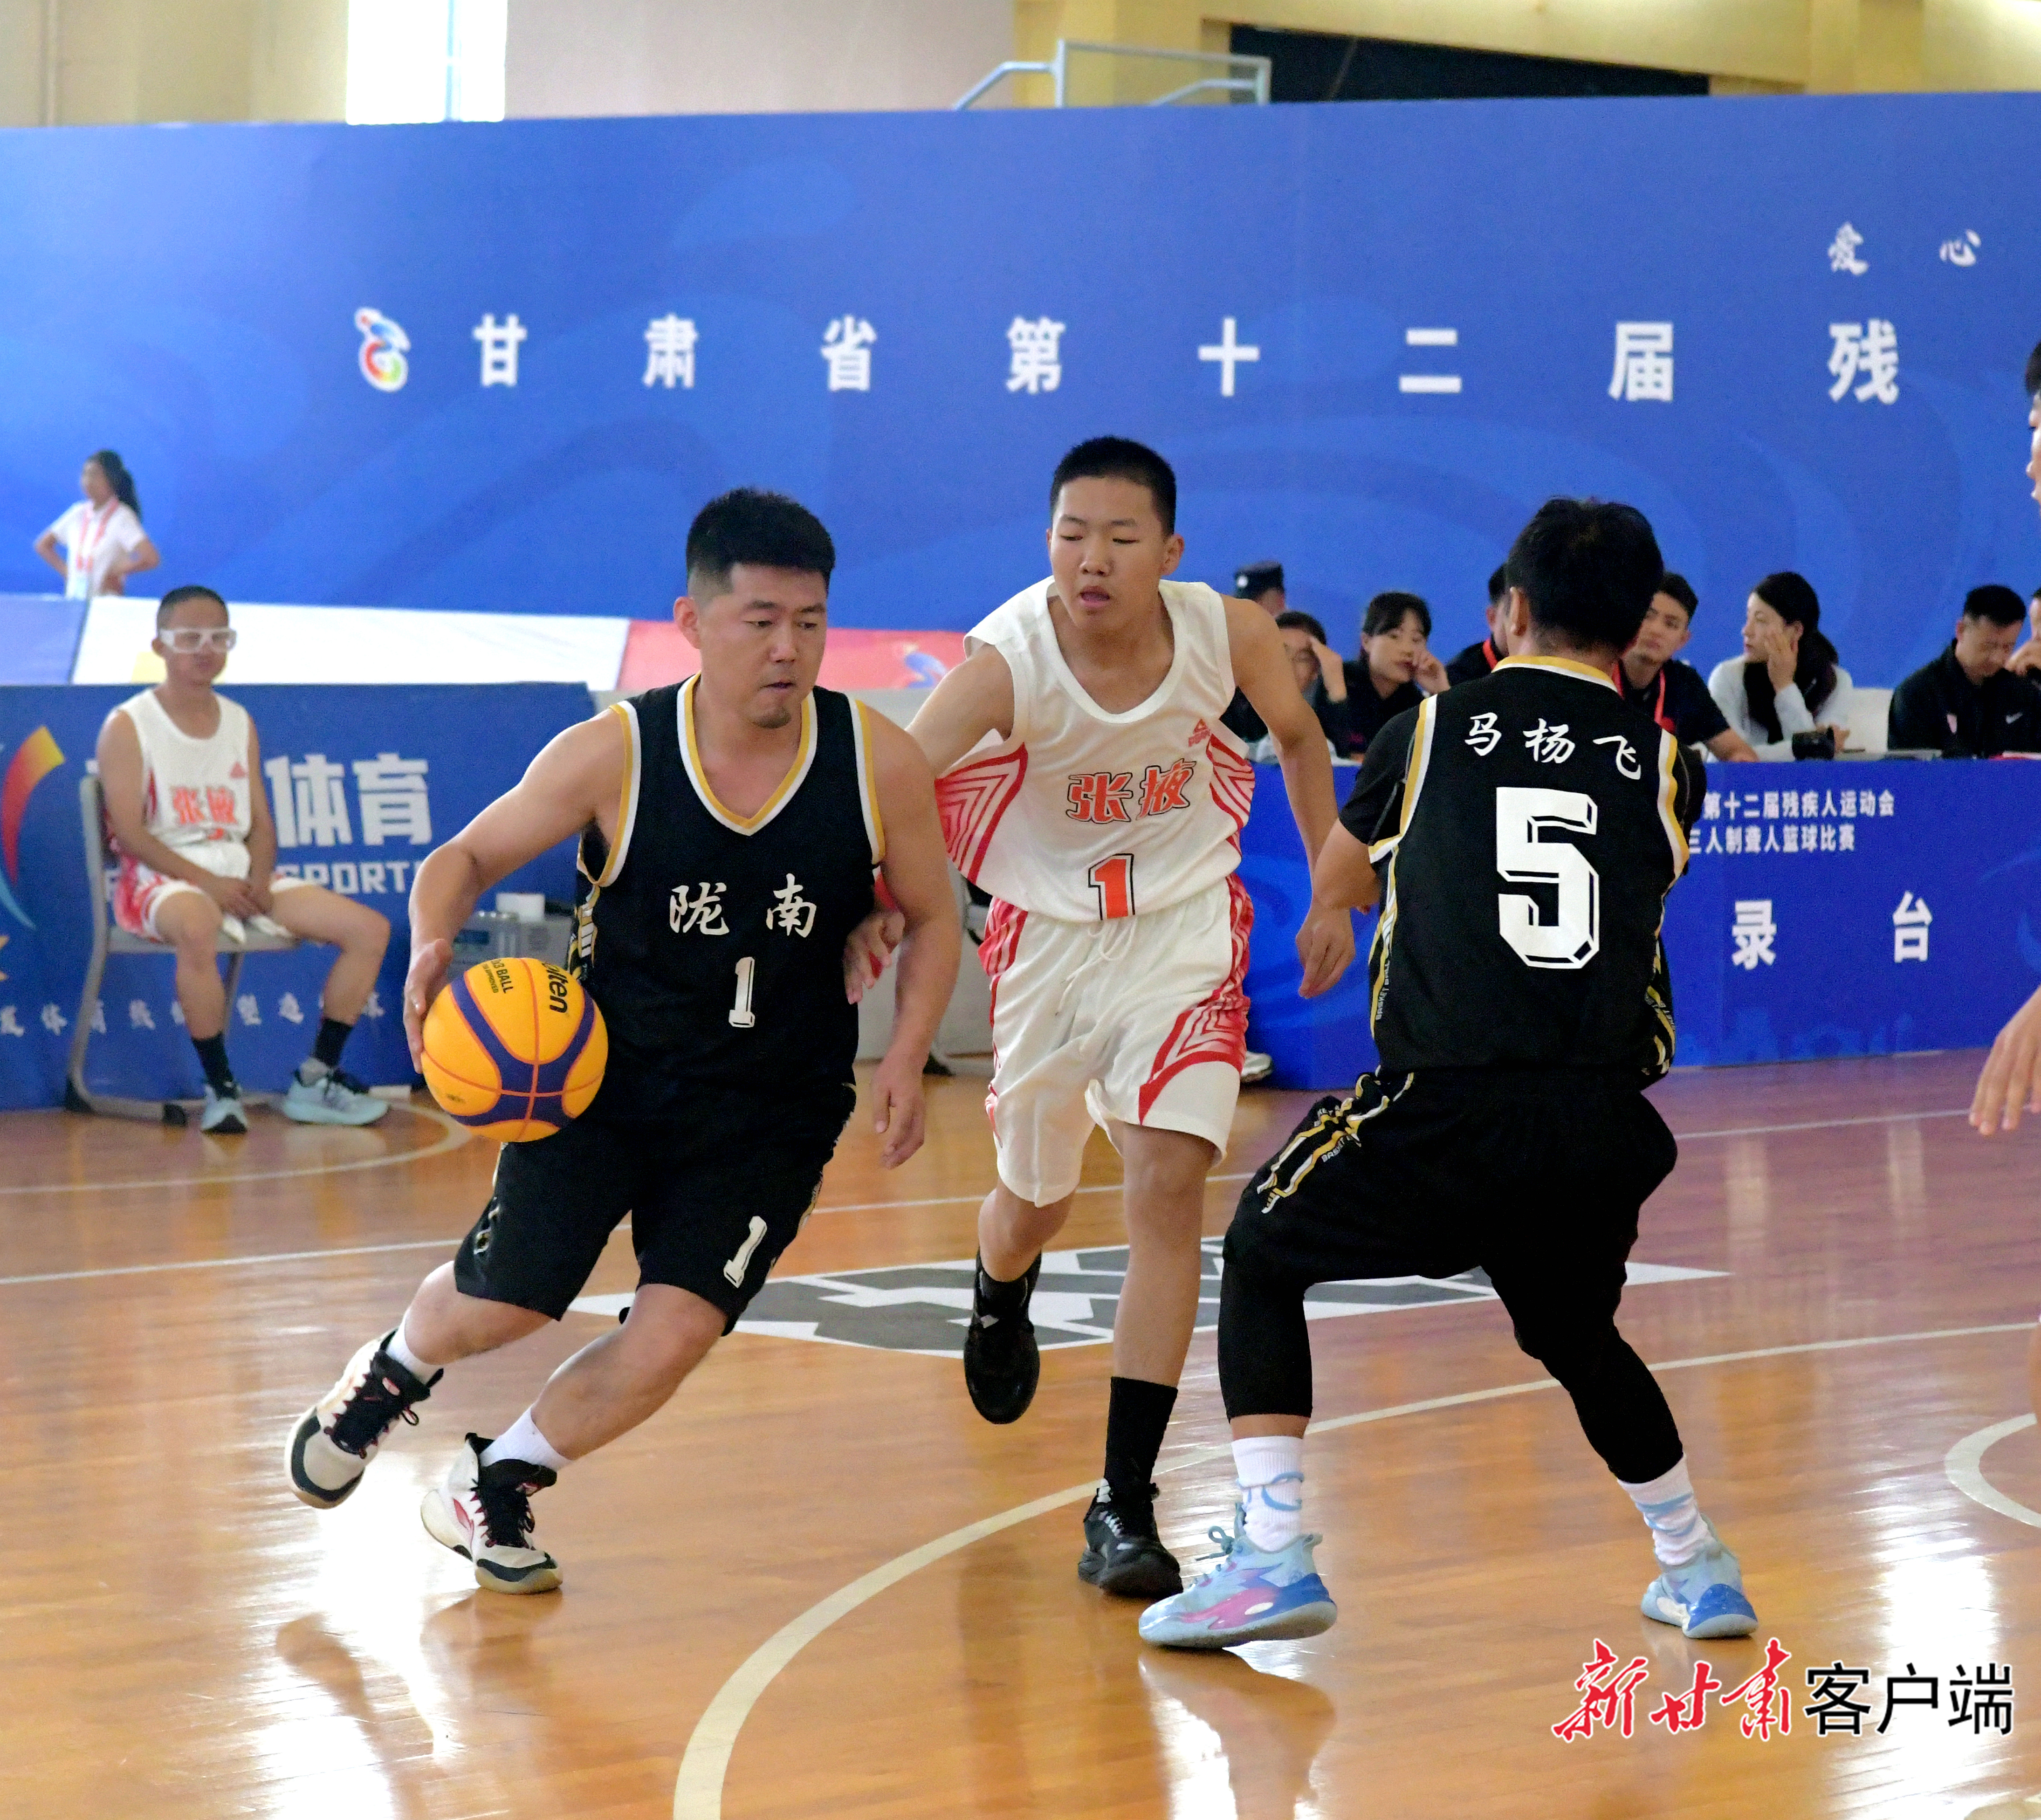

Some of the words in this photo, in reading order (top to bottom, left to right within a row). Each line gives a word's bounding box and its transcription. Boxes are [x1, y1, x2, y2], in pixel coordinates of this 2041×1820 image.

[1464, 712, 1642, 781] 马杨飞
[1065, 757, 1197, 824] 张掖
[669, 872, 818, 938] 陇南
[1087, 852, 1135, 920] 1
[1496, 786, 1600, 970] 5
[496, 968, 514, 994] BALL
[728, 955, 756, 1028] 1
[723, 1215, 767, 1288] 1
